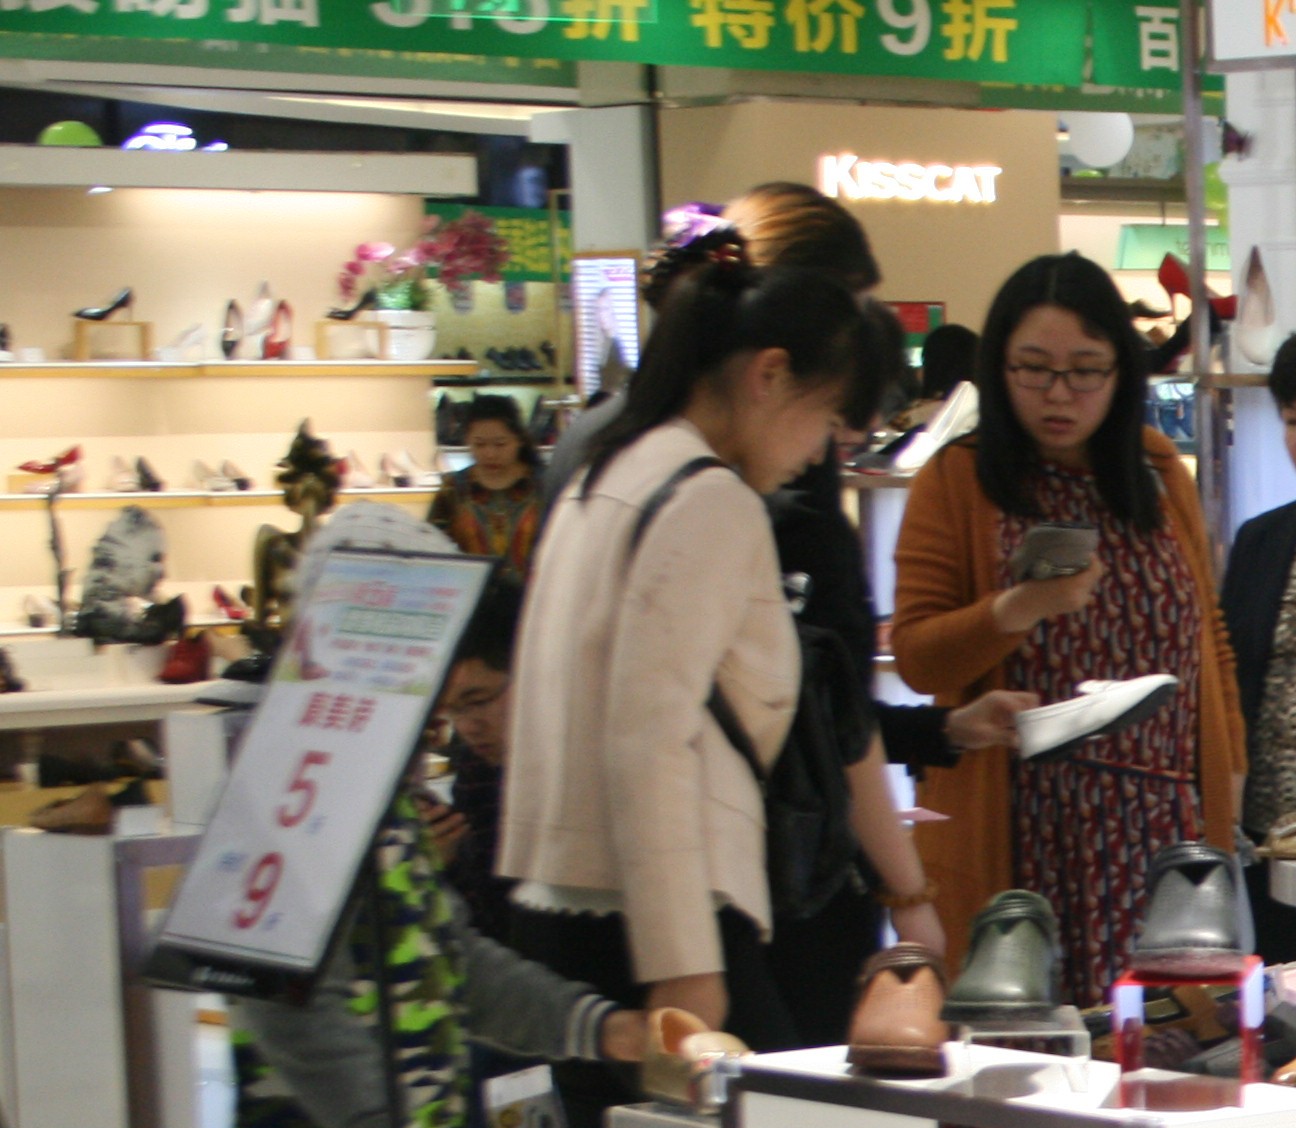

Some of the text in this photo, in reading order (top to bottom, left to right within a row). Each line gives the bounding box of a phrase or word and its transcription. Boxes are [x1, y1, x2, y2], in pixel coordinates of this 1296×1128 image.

[691, 0, 1018, 63] 特价9折
[1135, 5, 1180, 71] 百
